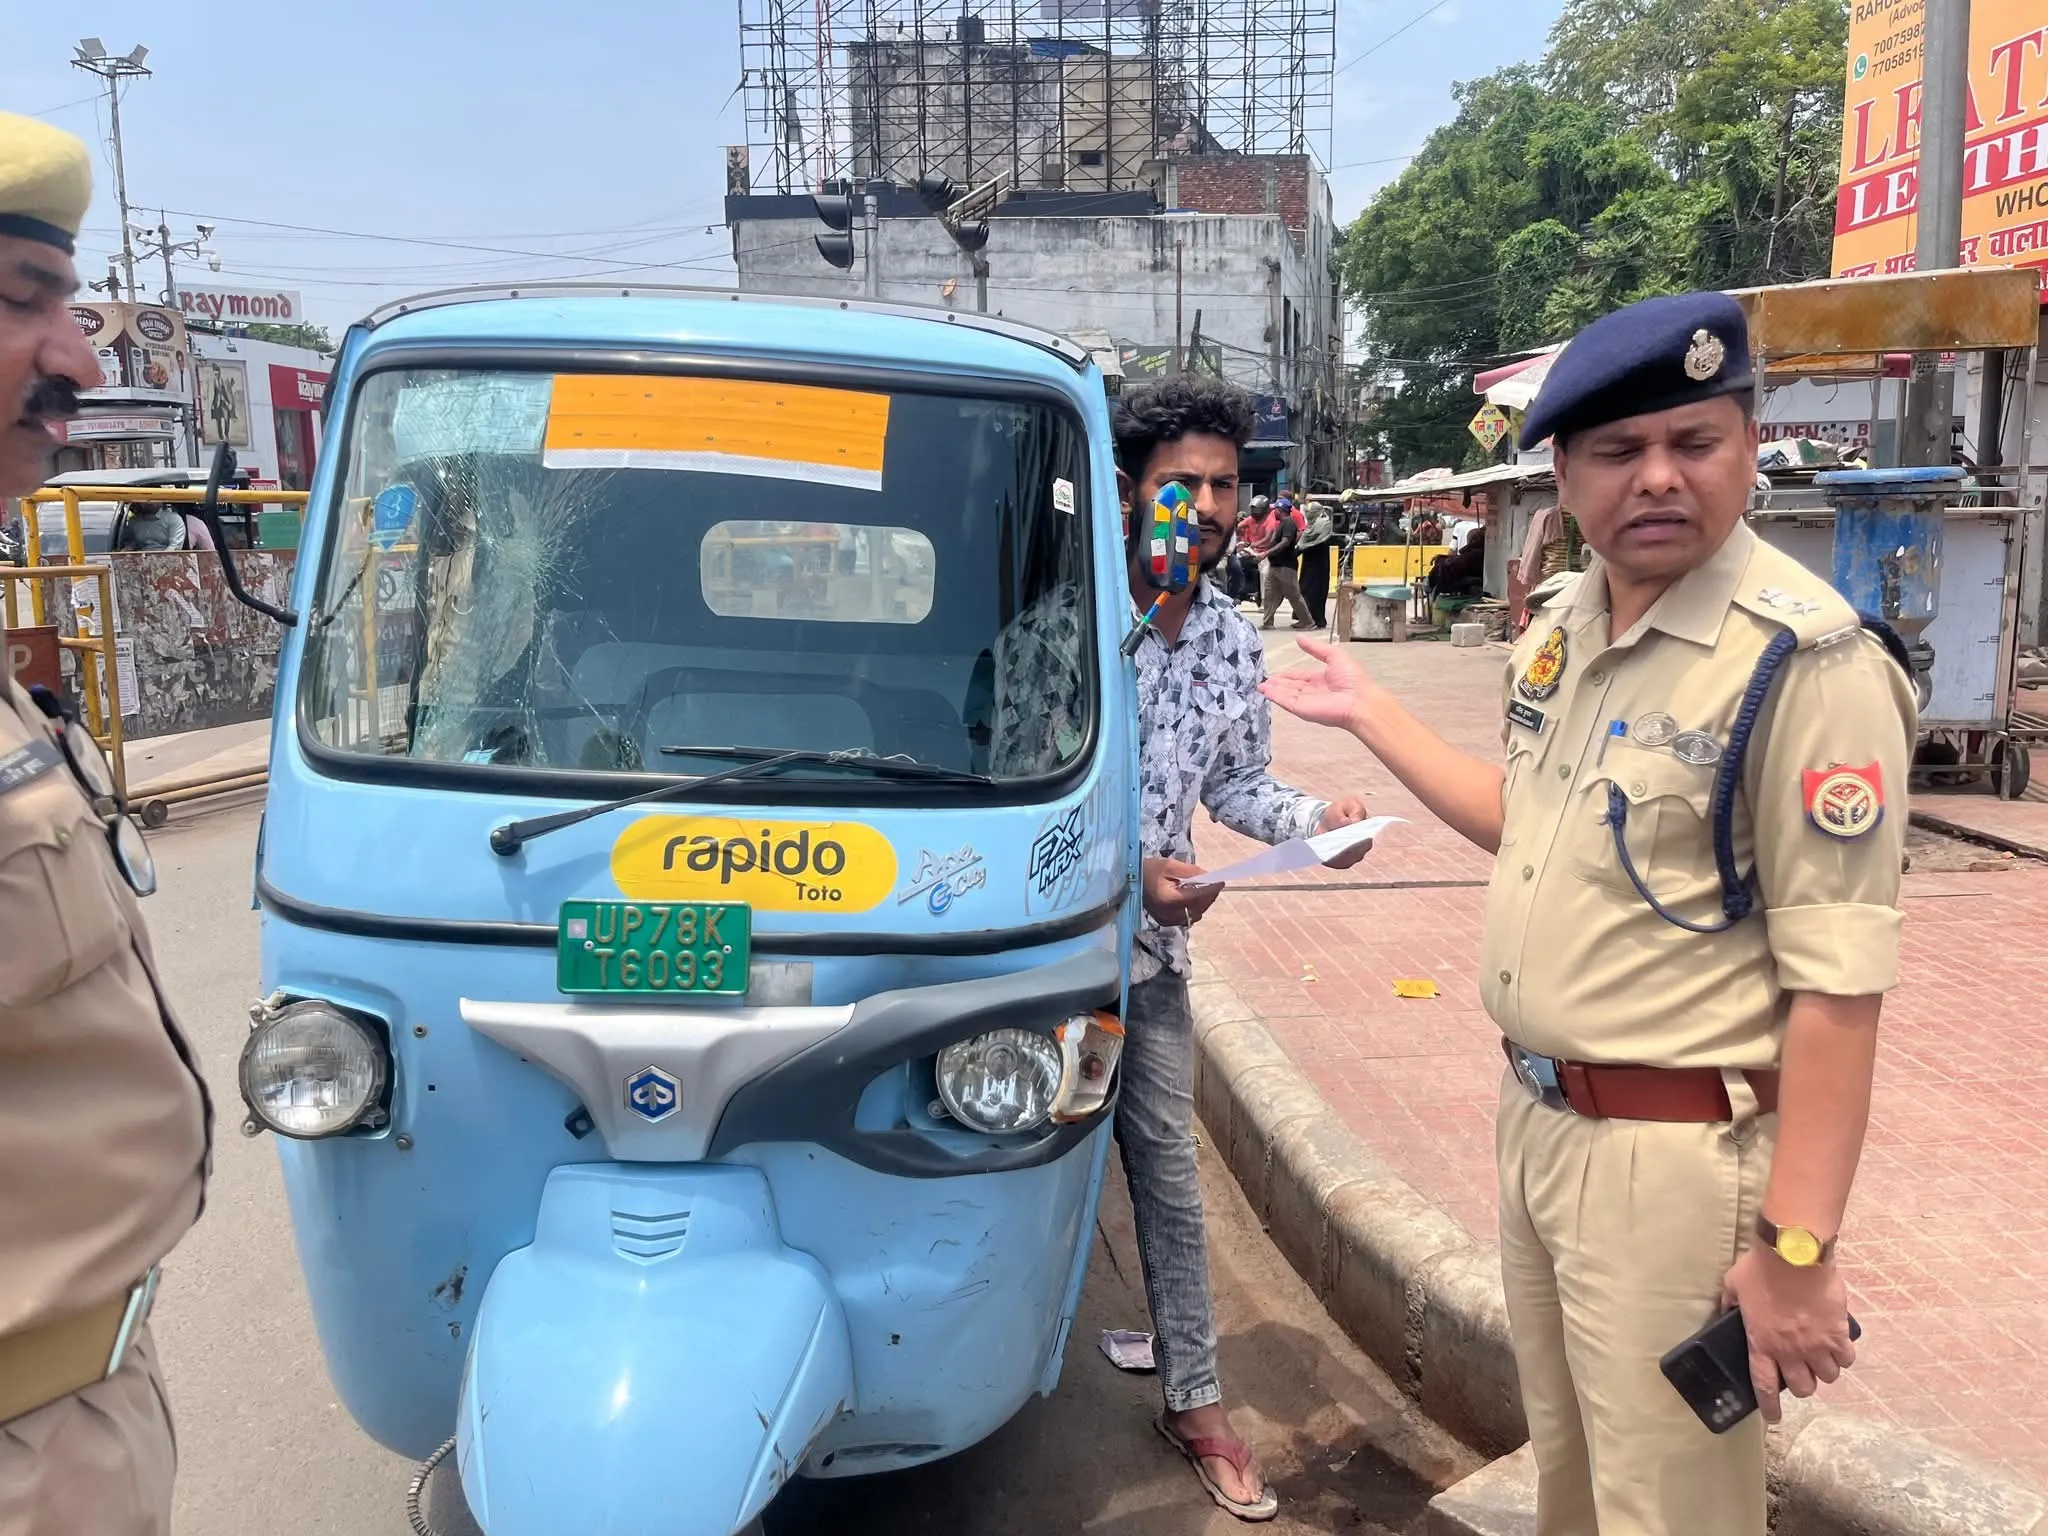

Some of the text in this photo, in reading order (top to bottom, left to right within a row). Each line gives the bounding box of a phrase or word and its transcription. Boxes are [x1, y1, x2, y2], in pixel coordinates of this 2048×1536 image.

[178, 291, 292, 320] Raymond
[663, 829, 846, 884] rapido
[1029, 803, 1083, 881] FX
[1038, 828, 1085, 895] MAX
[795, 882, 842, 901] Toto
[594, 904, 727, 946] UP78K
[593, 948, 724, 990] T6093
